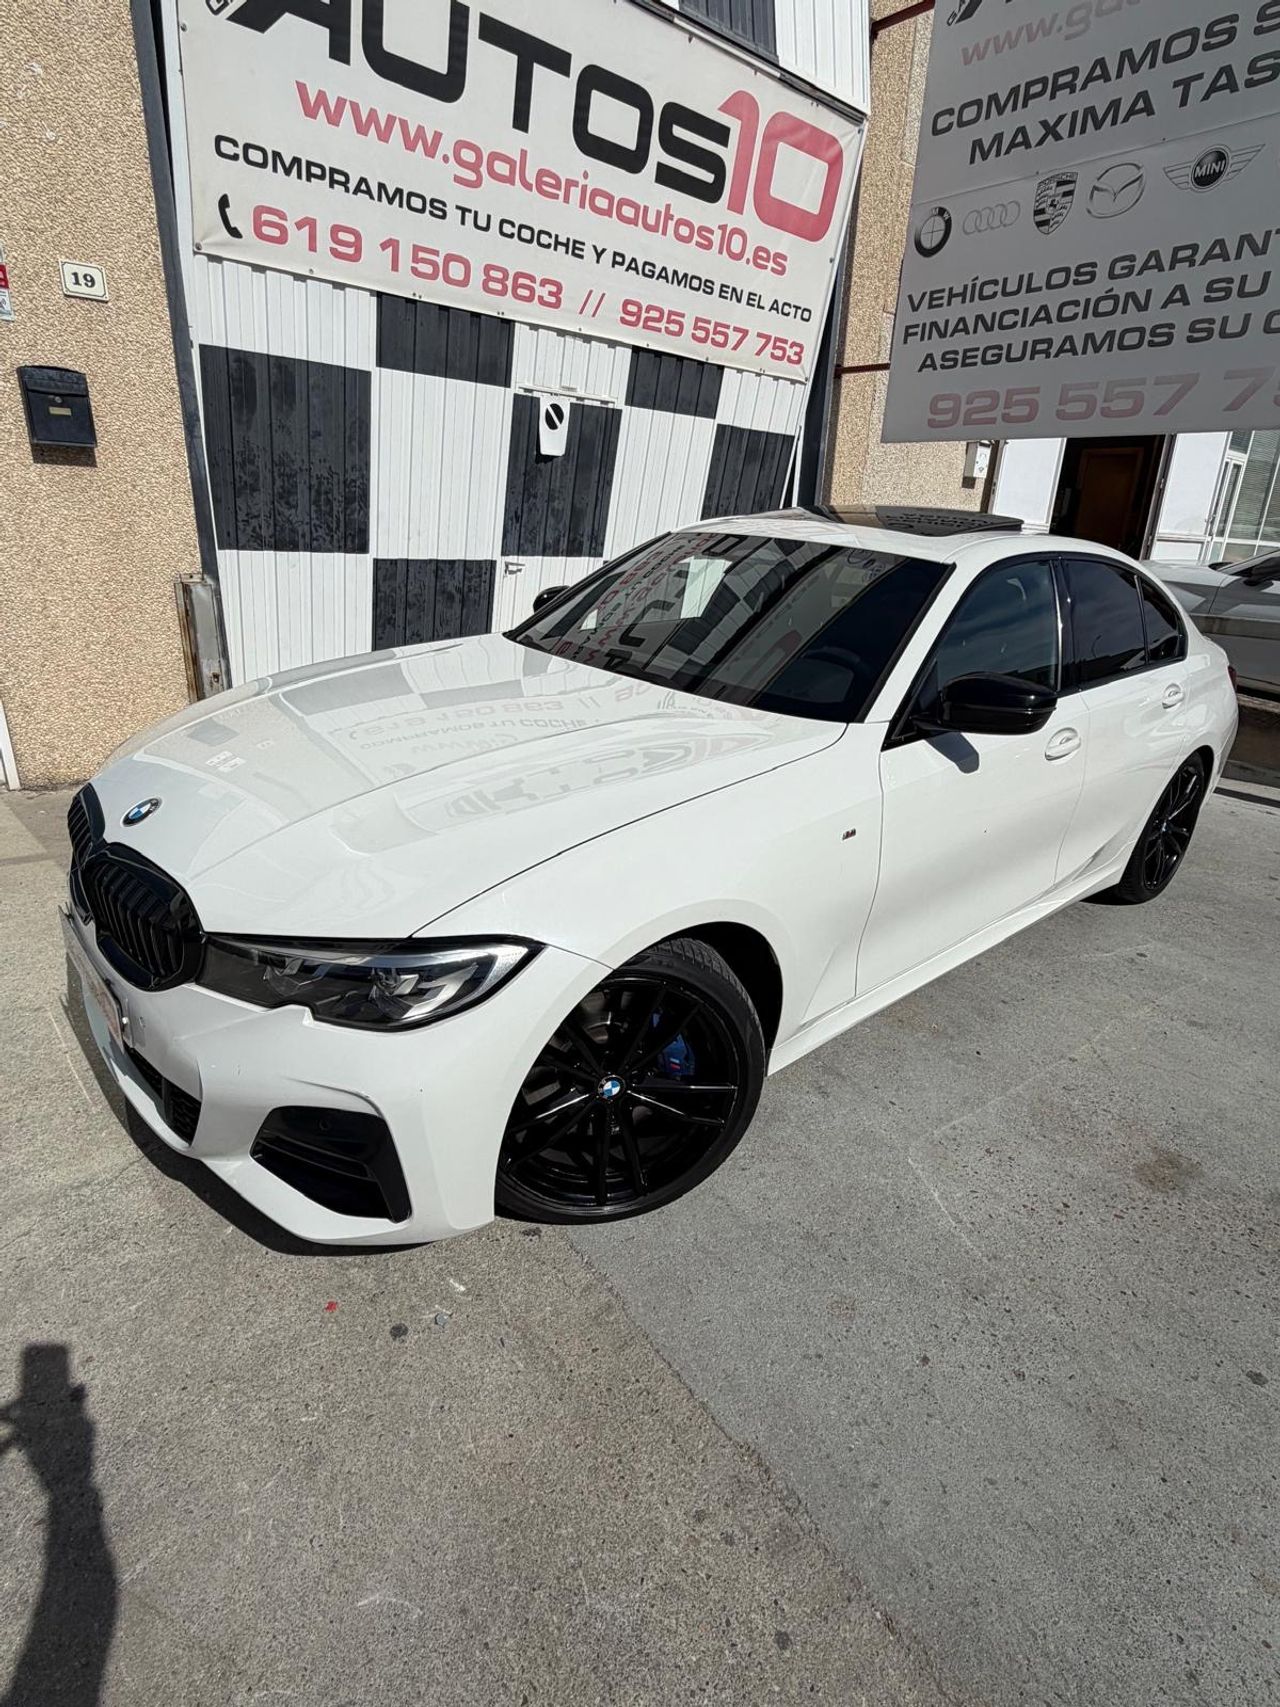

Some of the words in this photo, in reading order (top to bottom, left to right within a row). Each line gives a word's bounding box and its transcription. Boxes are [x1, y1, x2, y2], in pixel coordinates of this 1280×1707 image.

[961, 0, 1141, 66] www.ga
[931, 13, 1239, 136] COMPRAMOS
[969, 90, 1155, 164] MAXIMA
[1173, 50, 1280, 108] TAS
[295, 80, 788, 277] www.galeriaautos10.es
[1194, 159, 1226, 178] MINI
[214, 134, 447, 220] COMPRAMOS
[455, 204, 491, 232] TU
[498, 218, 586, 260] COCHE
[591, 245, 608, 264] Y
[611, 252, 715, 296] PAGAMOS
[718, 284, 744, 304] EN
[746, 292, 765, 310] EL
[768, 298, 812, 323] ACTO
[71, 271, 96, 288] 19
[252, 205, 363, 263] 619
[379, 237, 472, 289] 150
[481, 263, 564, 310] 863
[619, 298, 685, 338] 925
[691, 316, 749, 351] 557
[755, 332, 805, 365] 753
[903, 286, 1151, 344] FINANCIACIÓN
[1161, 284, 1191, 309] A
[1203, 270, 1272, 302] SU
[908, 261, 1097, 312] VEHÍCULOS
[1107, 228, 1280, 279] GARAN
[917, 323, 1175, 372] ASEGURAMOS
[1186, 312, 1252, 344] SU
[927, 386, 1040, 429] 925
[1055, 372, 1200, 421] 557
[1222, 366, 1280, 412] 7
